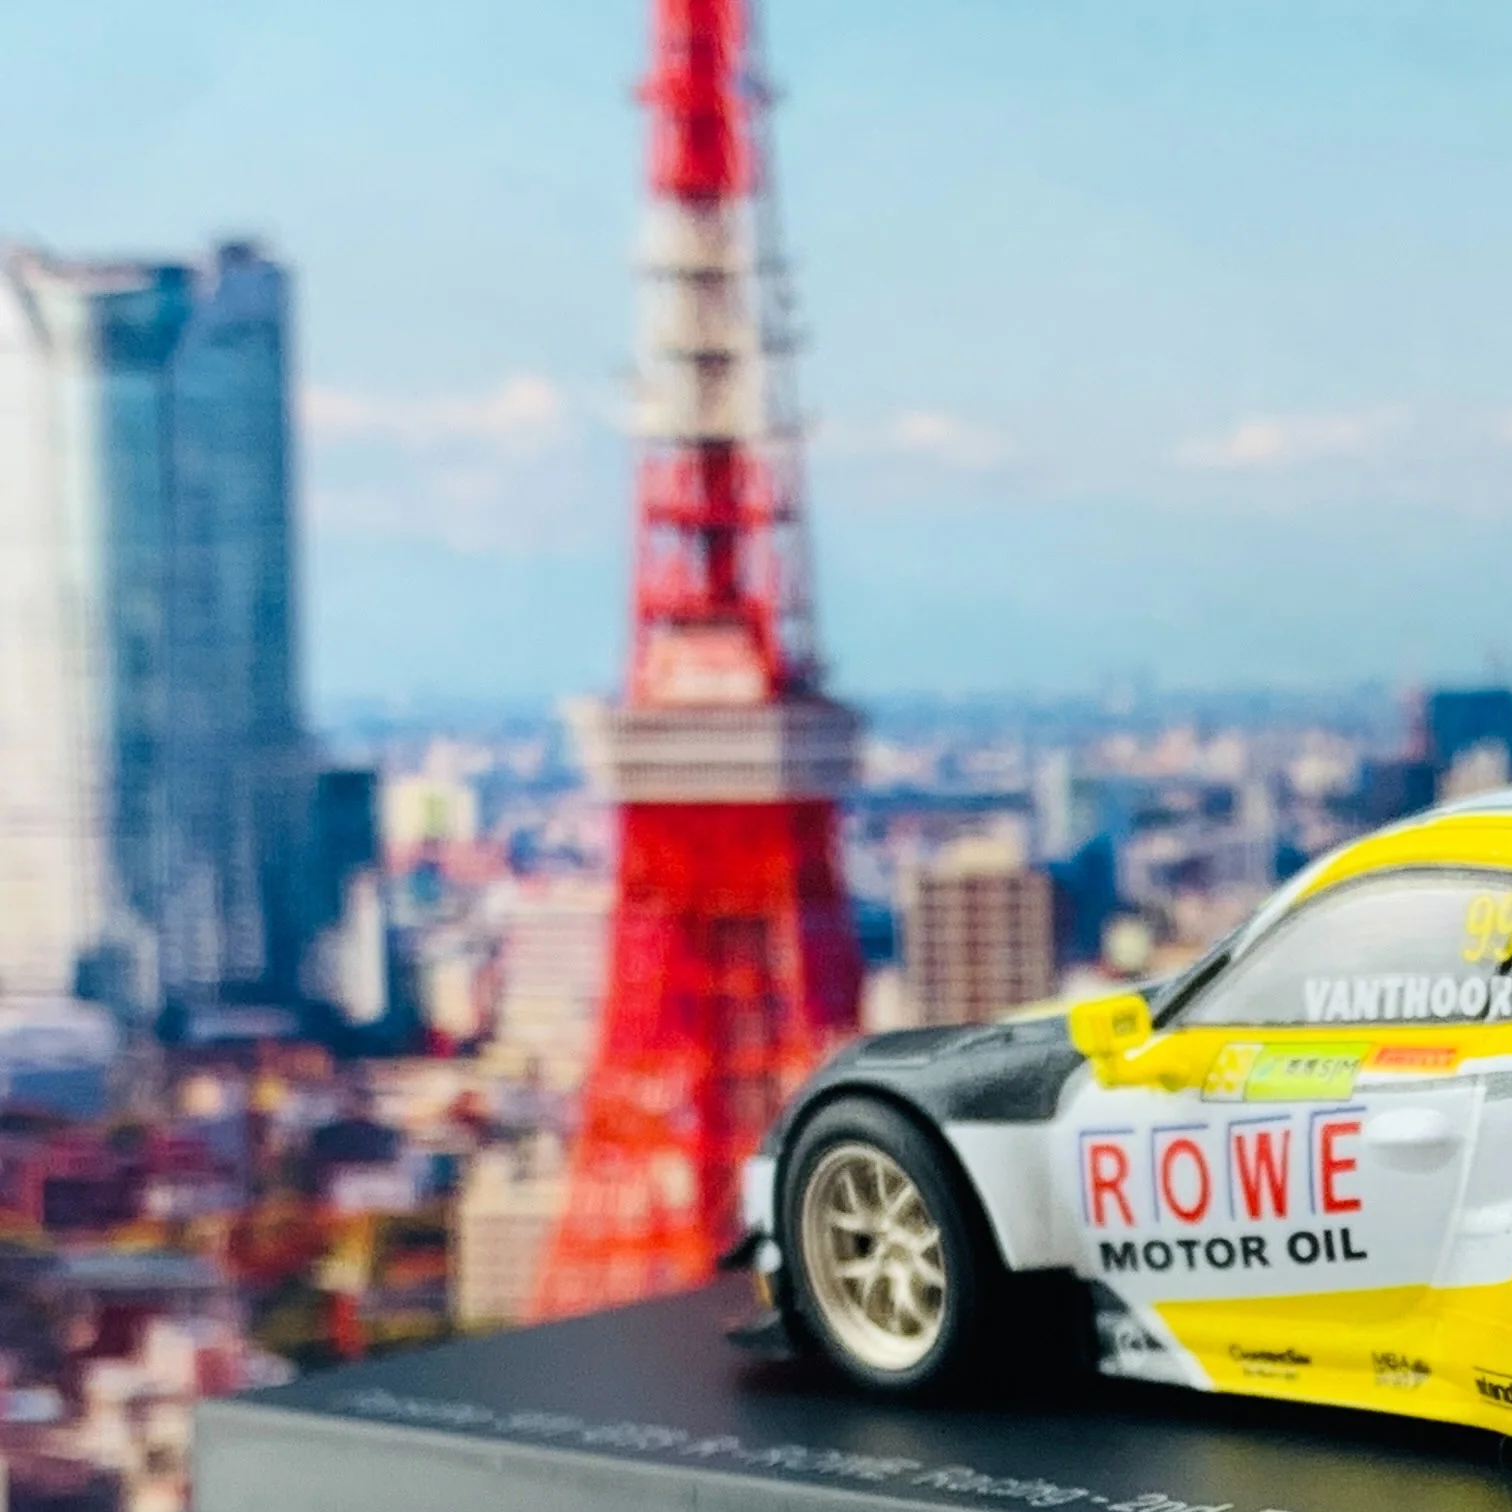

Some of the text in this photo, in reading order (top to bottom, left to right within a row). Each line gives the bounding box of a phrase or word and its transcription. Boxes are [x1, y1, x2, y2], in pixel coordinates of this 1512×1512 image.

[1086, 1117, 1363, 1229] ROWE
[1100, 1227, 1368, 1273] MOTOR OIL
